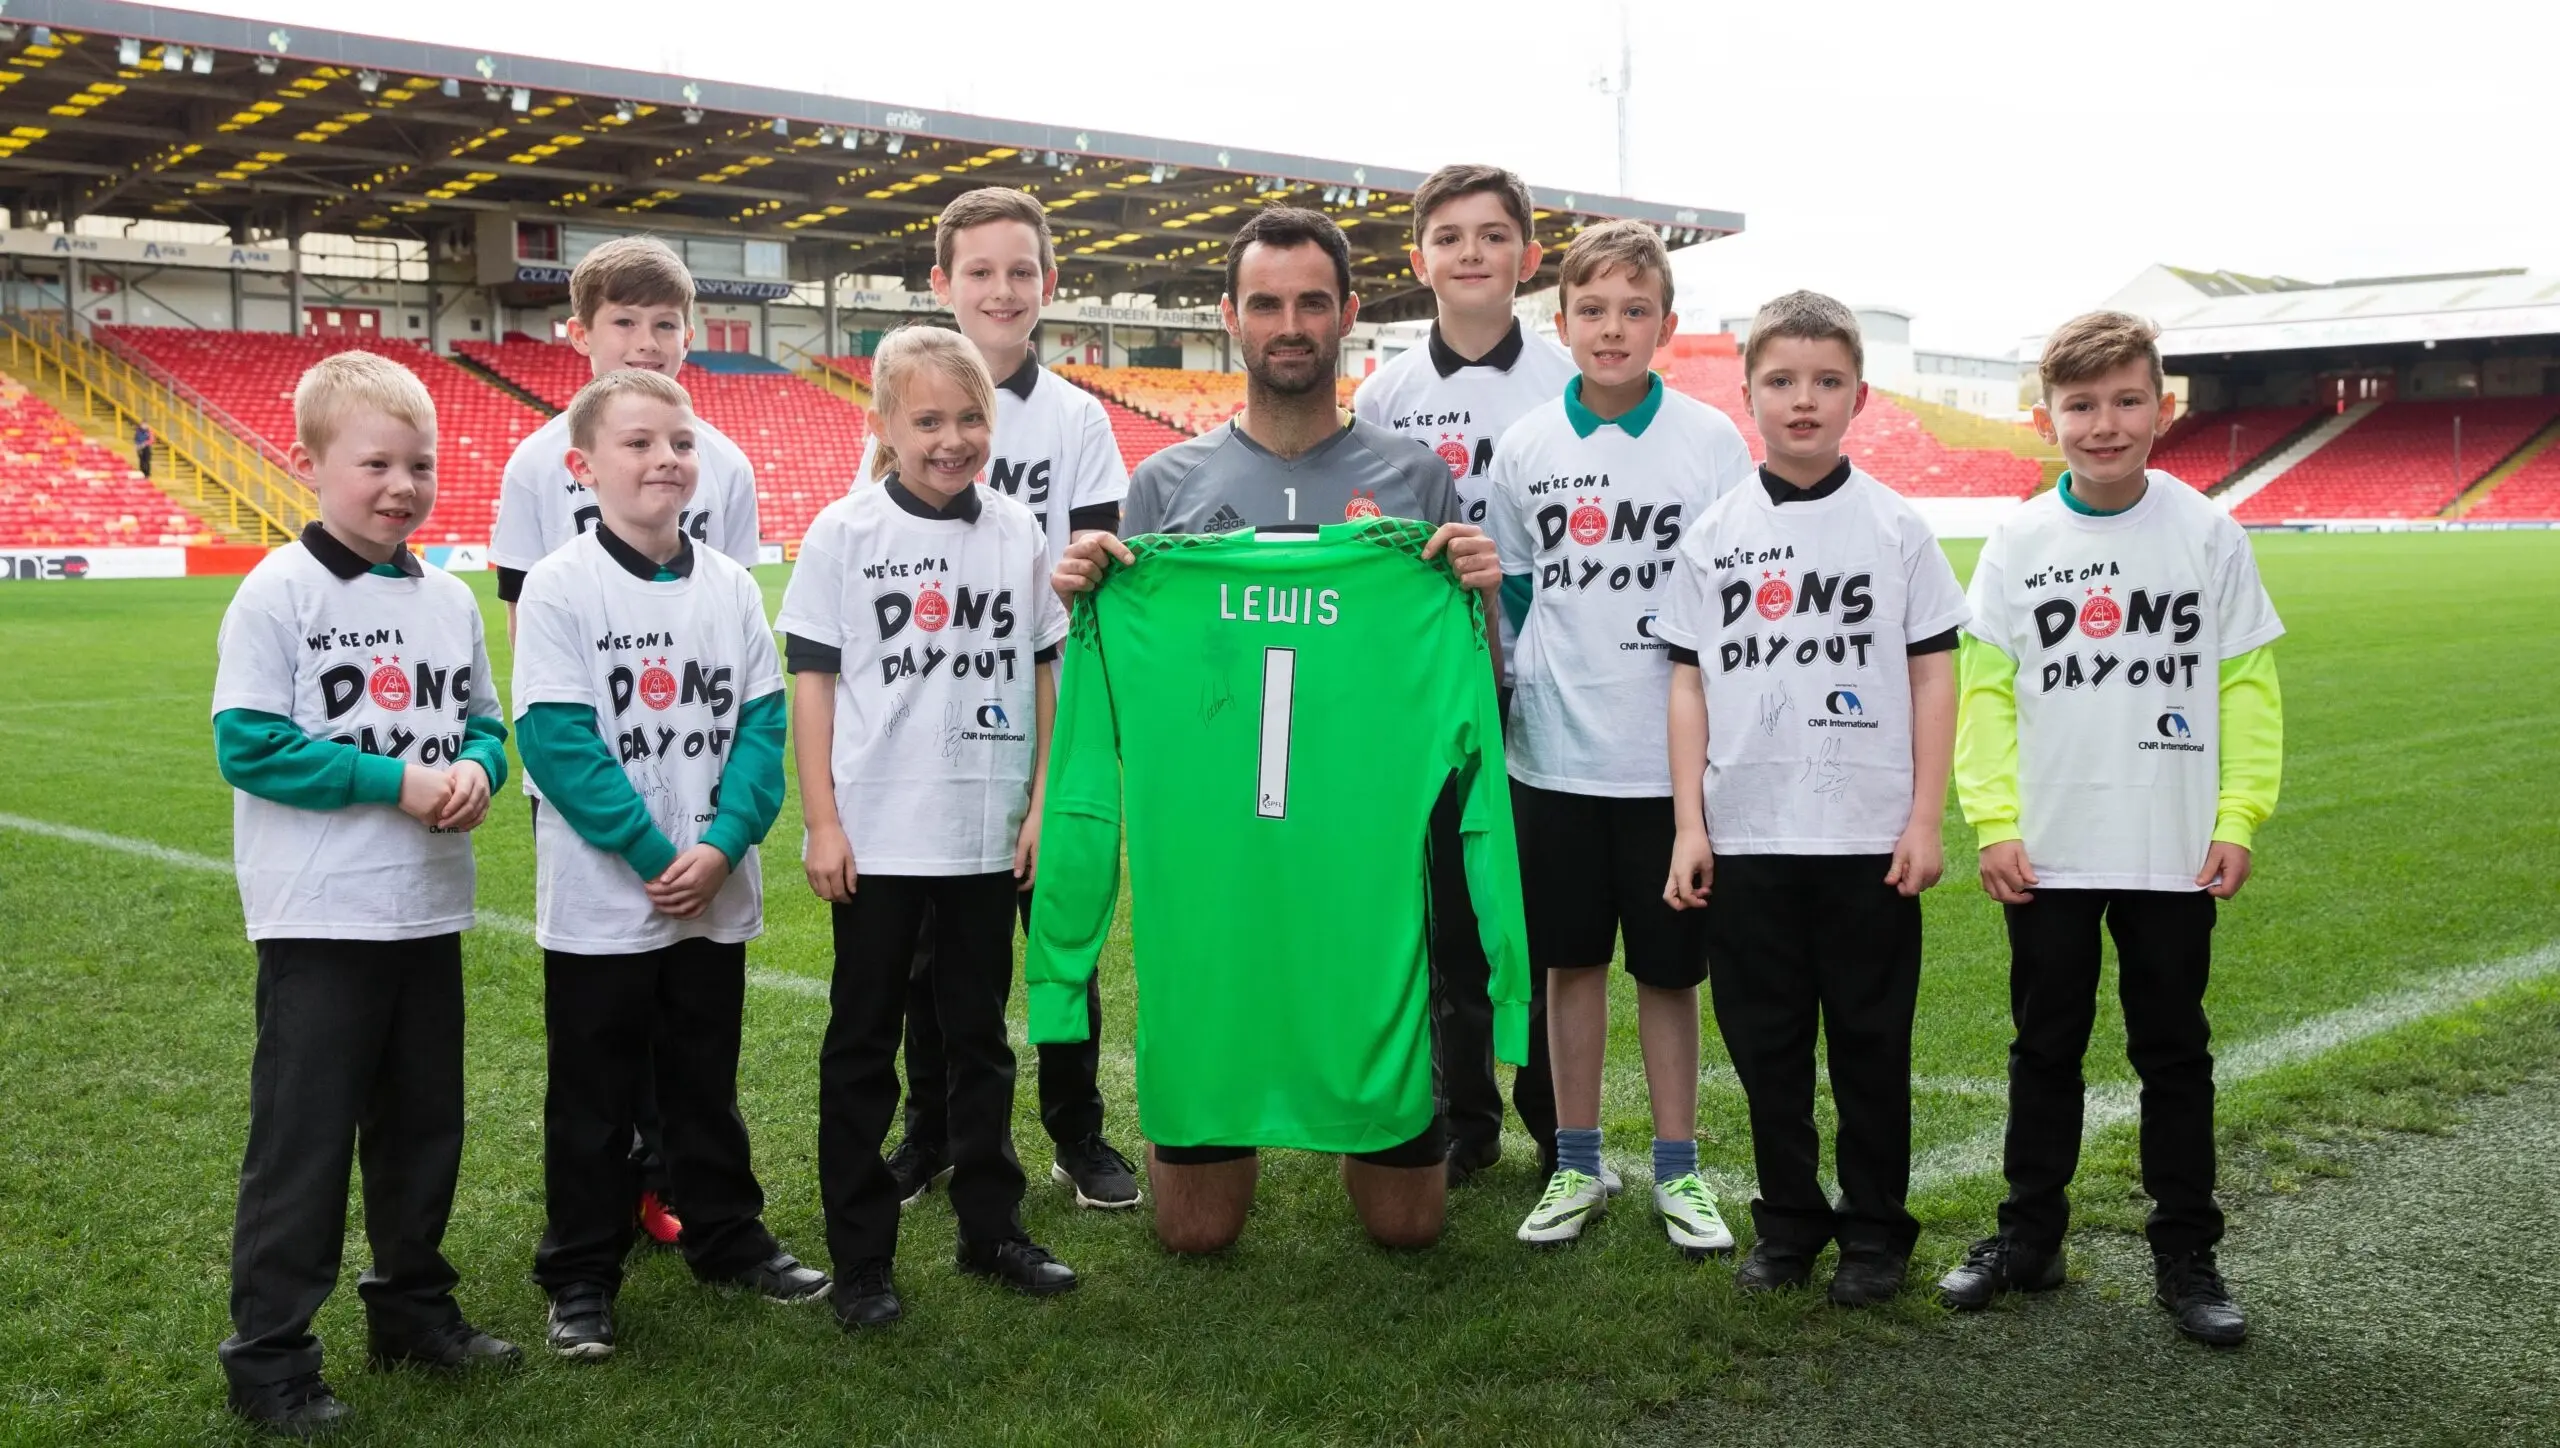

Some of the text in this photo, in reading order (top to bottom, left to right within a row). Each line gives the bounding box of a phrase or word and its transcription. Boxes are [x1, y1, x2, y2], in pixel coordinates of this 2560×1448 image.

[694, 279, 756, 296] NSPORT
[757, 283, 789, 297] LTD
[1078, 306, 1220, 326] ABERDEEN FABRICATI
[1393, 410, 1471, 430] WE'RE ON A
[1529, 474, 1610, 496] WE'RE ON A
[1284, 488, 1296, 521] 1
[1204, 518, 1246, 533] adidas
[1758, 547, 1781, 563] ON
[1785, 545, 1794, 559] A
[863, 558, 948, 579] WE'RE ON A
[1541, 556, 1607, 594] DAY
[2025, 561, 2120, 589] WE'RE ON A
[1220, 583, 1340, 626] LEWIS
[307, 628, 360, 651] WE'RE
[365, 629, 389, 647] ON
[597, 631, 673, 652] W'RE ON A
[1620, 642, 1670, 650] CNR Interna
[1718, 630, 1875, 675] DAY OUT
[879, 642, 1017, 688] DAY OUT
[2040, 650, 2201, 695] DAY OUT
[1256, 645, 1297, 820] 1
[1808, 719, 1878, 729] CNR International
[616, 722, 680, 768] DAY
[961, 732, 1026, 742] CNR International
[2138, 741, 2205, 752] CNR International
[419, 732, 463, 767] OU
